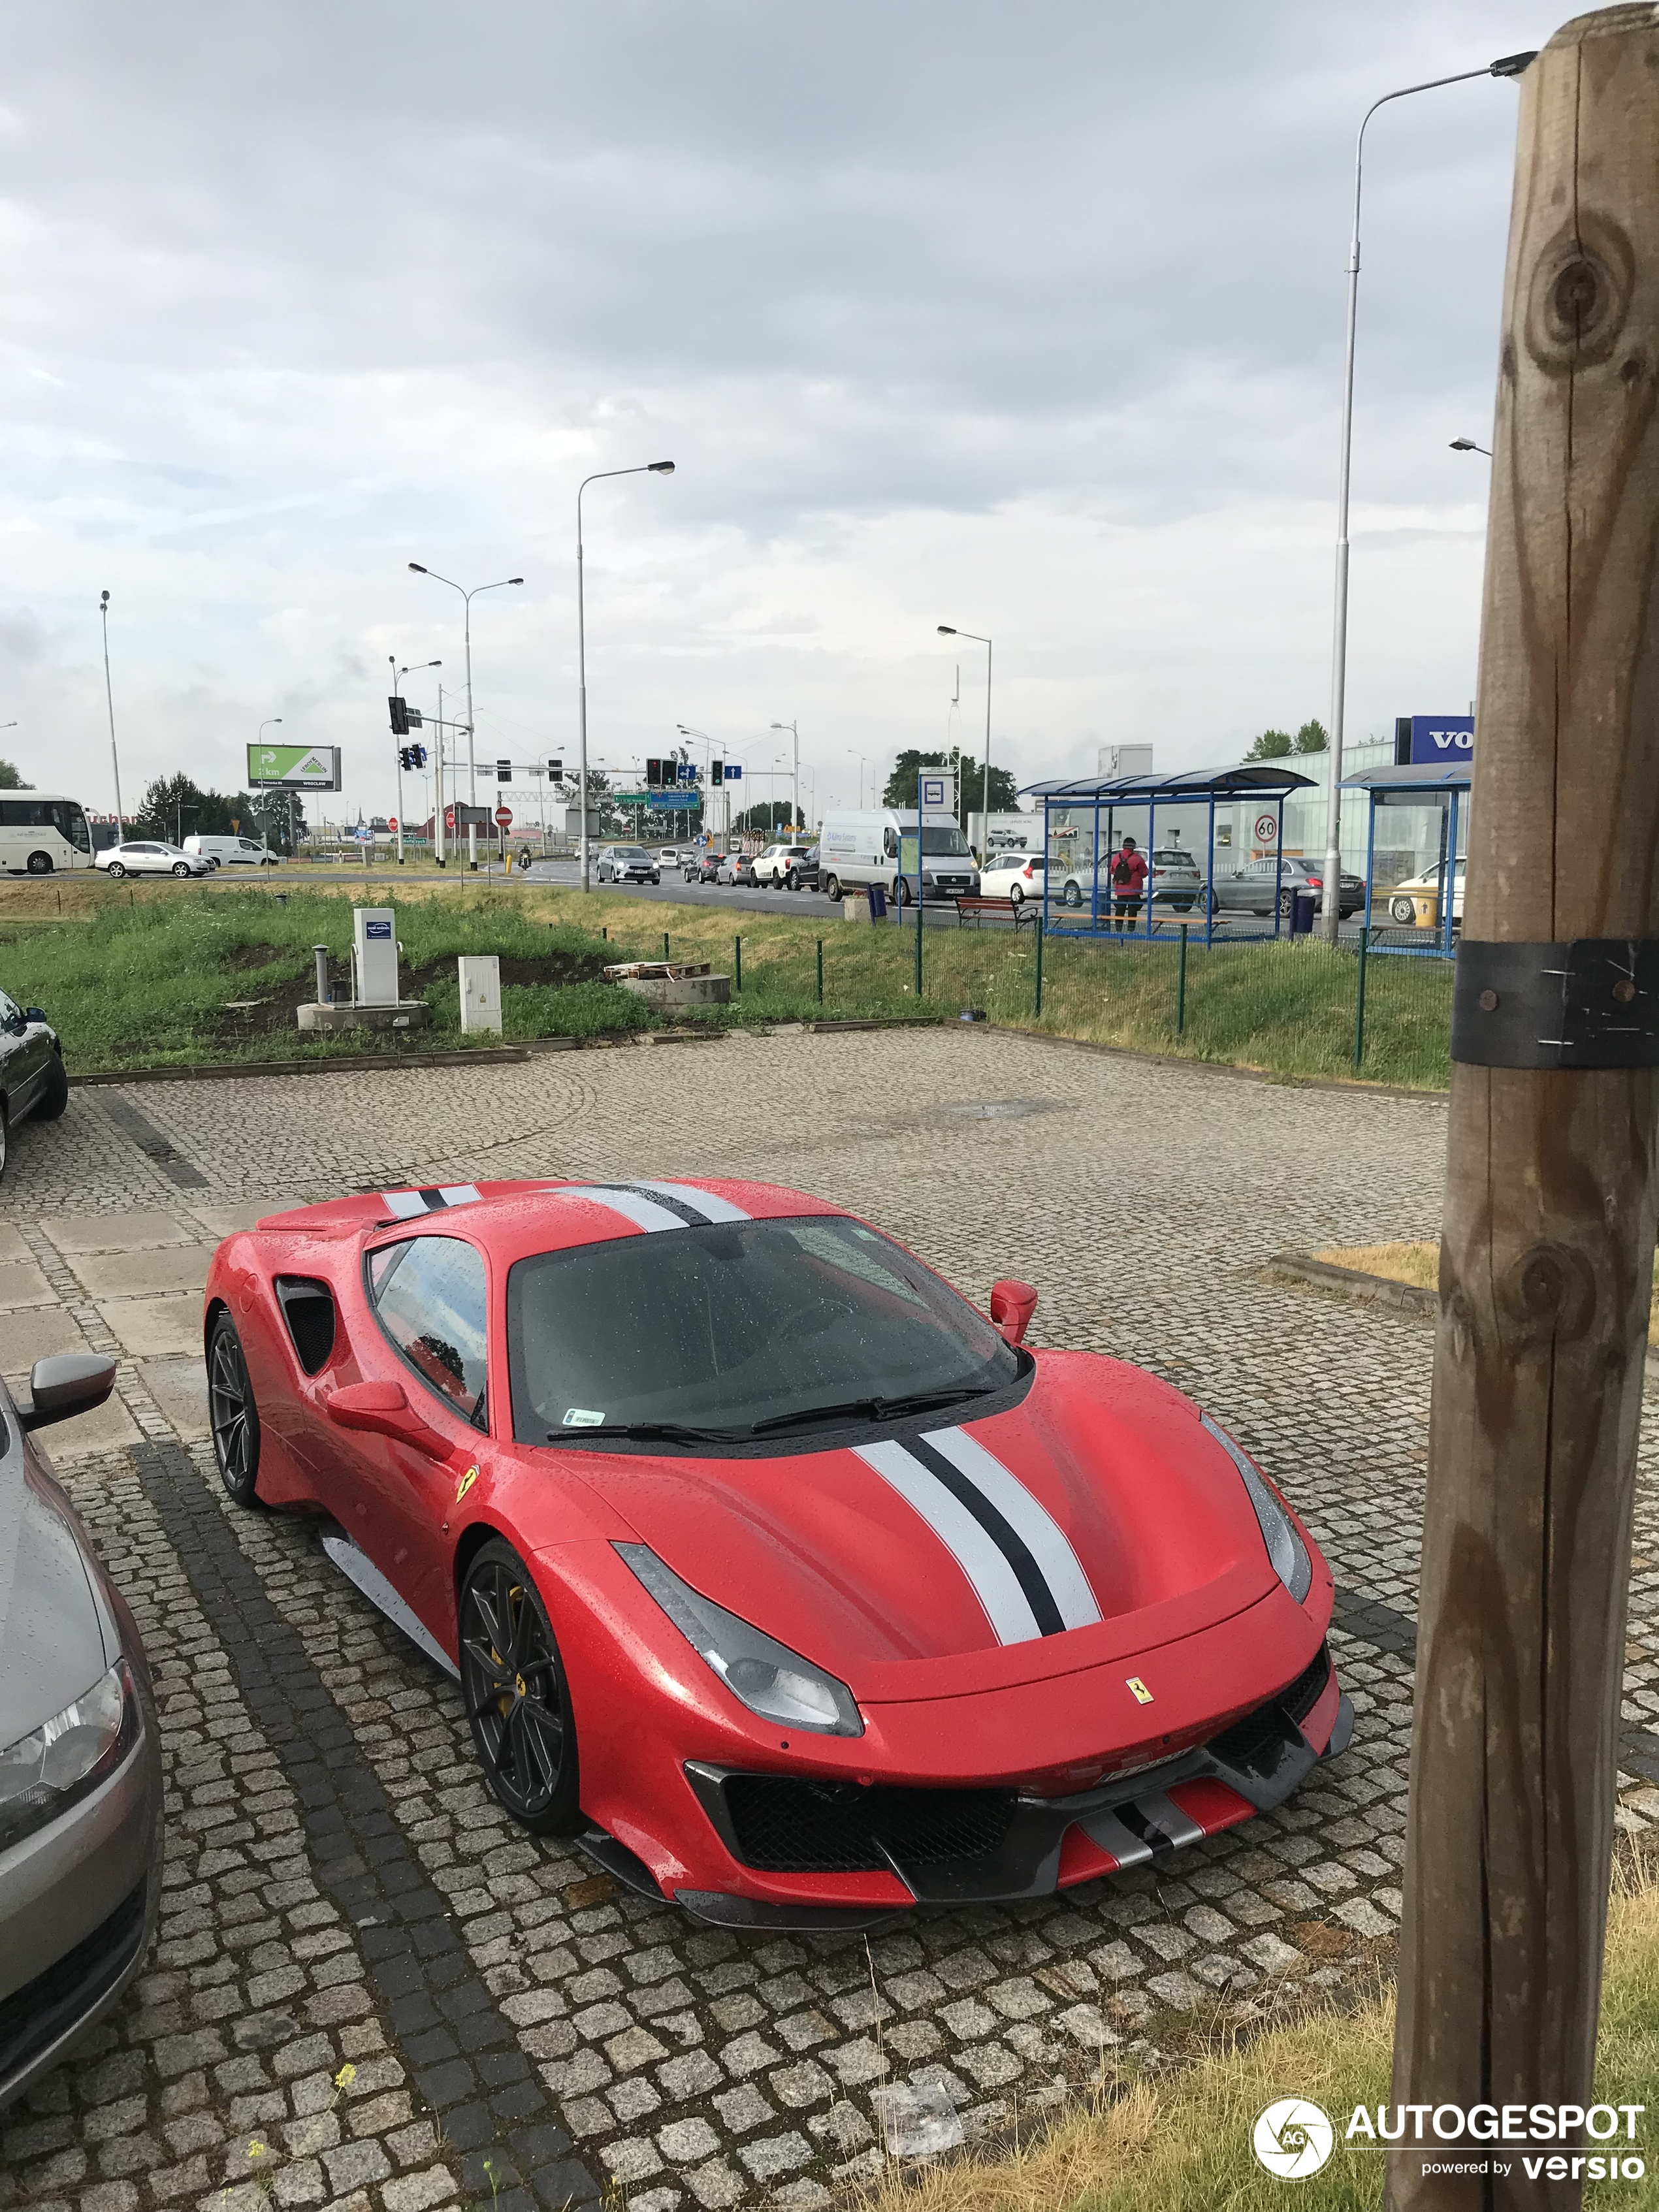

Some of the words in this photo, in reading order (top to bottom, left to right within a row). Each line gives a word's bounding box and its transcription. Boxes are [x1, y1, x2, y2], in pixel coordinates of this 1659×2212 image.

[300, 760, 313, 773] LEROY
[311, 756, 328, 773] MERLIN
[258, 767, 264, 776] 2
[265, 767, 280, 776] km
[1258, 822, 1274, 835] 60
